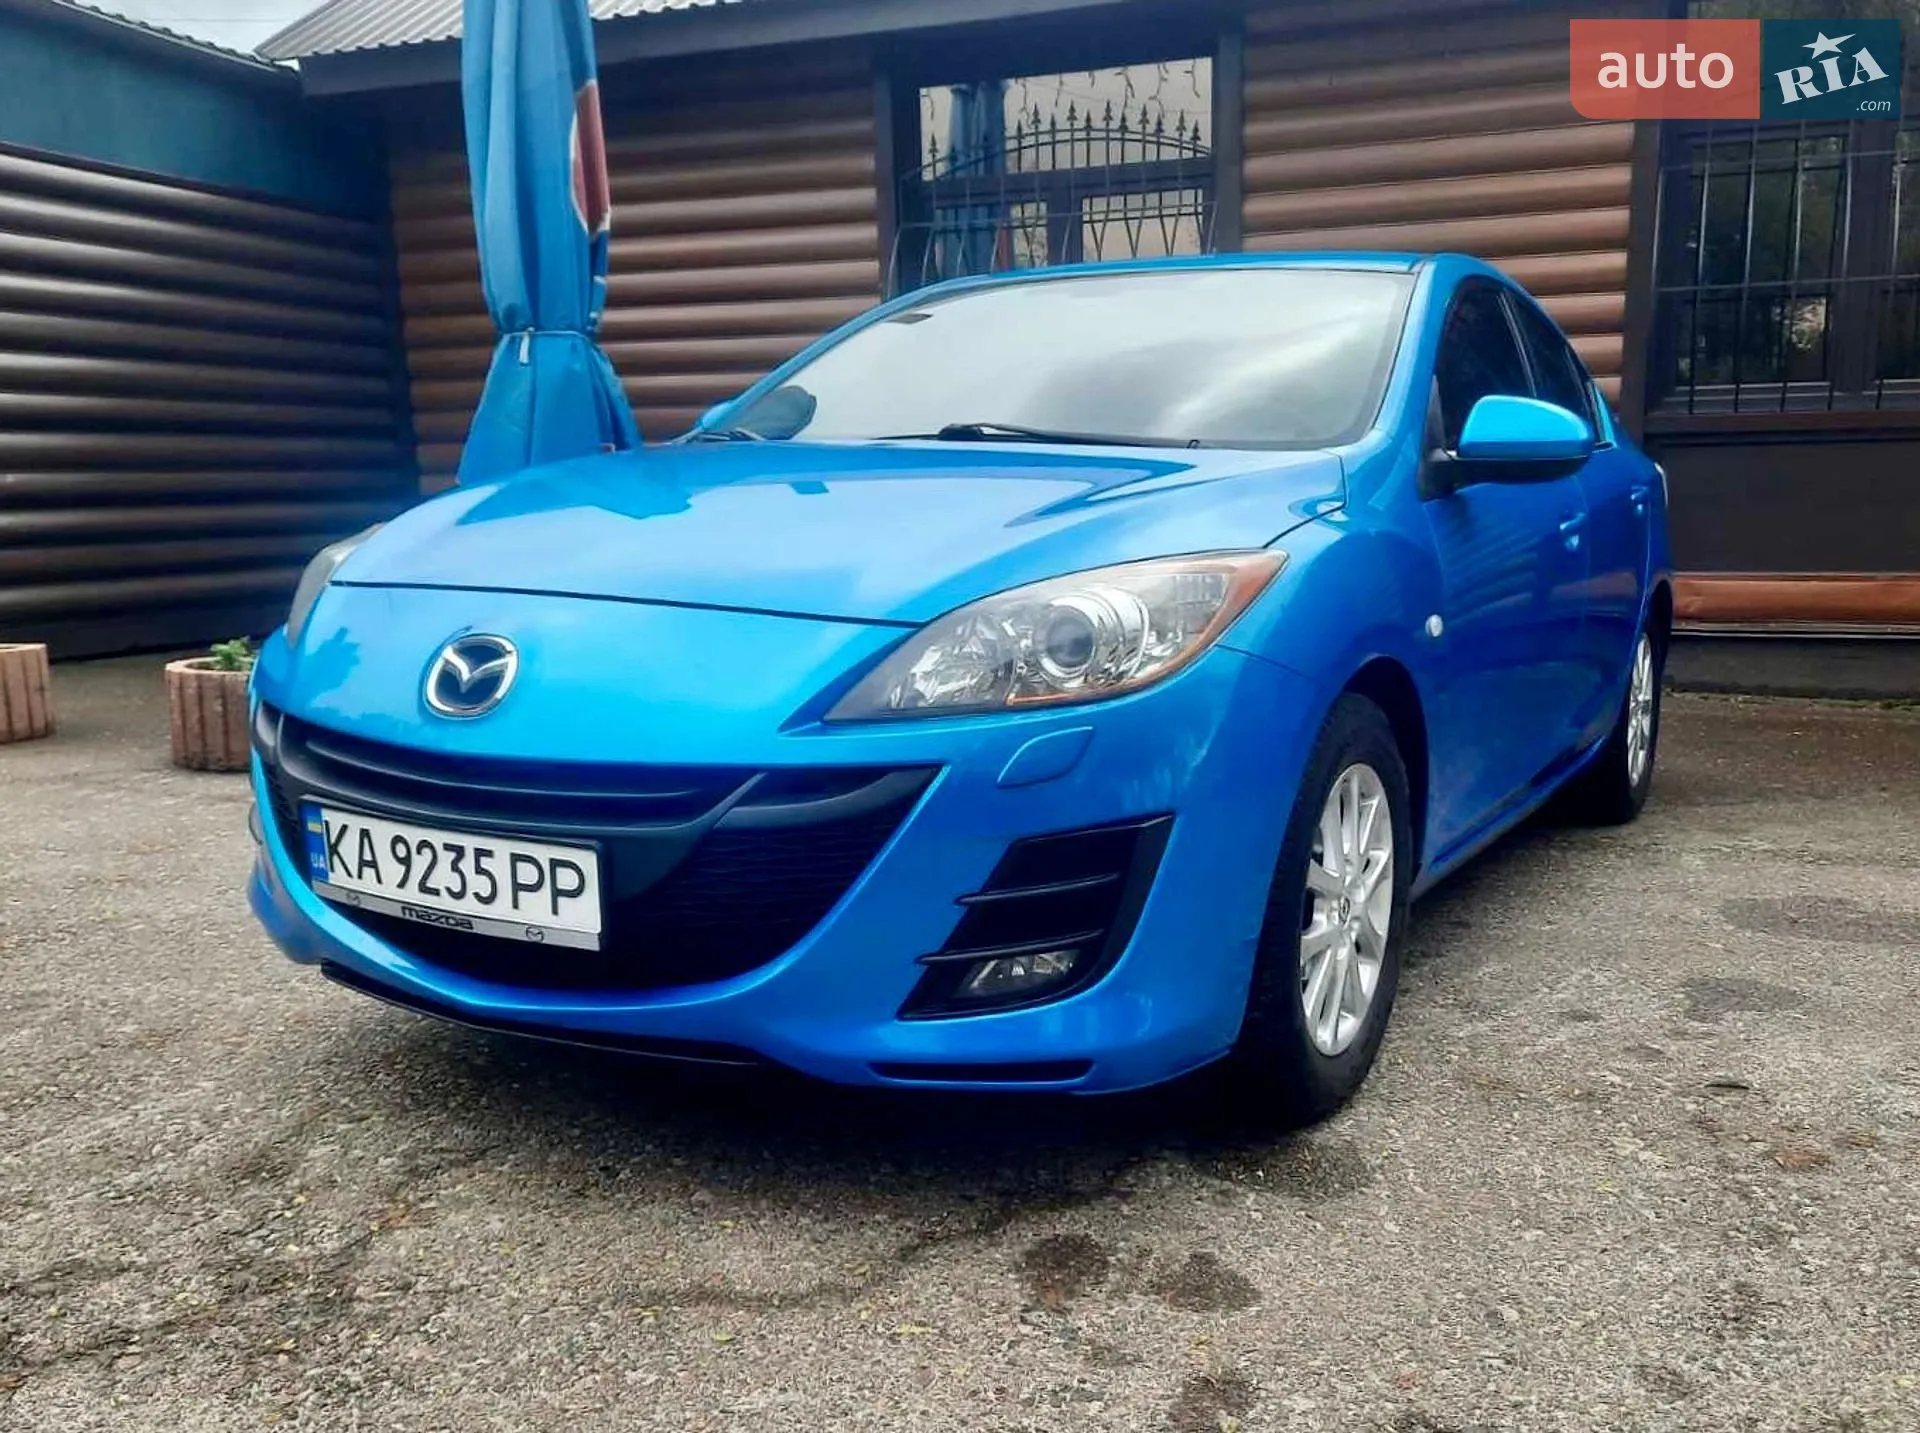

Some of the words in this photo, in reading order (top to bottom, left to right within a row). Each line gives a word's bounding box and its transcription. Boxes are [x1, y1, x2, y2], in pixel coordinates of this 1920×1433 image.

[324, 820, 384, 885] KA
[390, 834, 498, 905] 9235
[509, 852, 586, 916] PP
